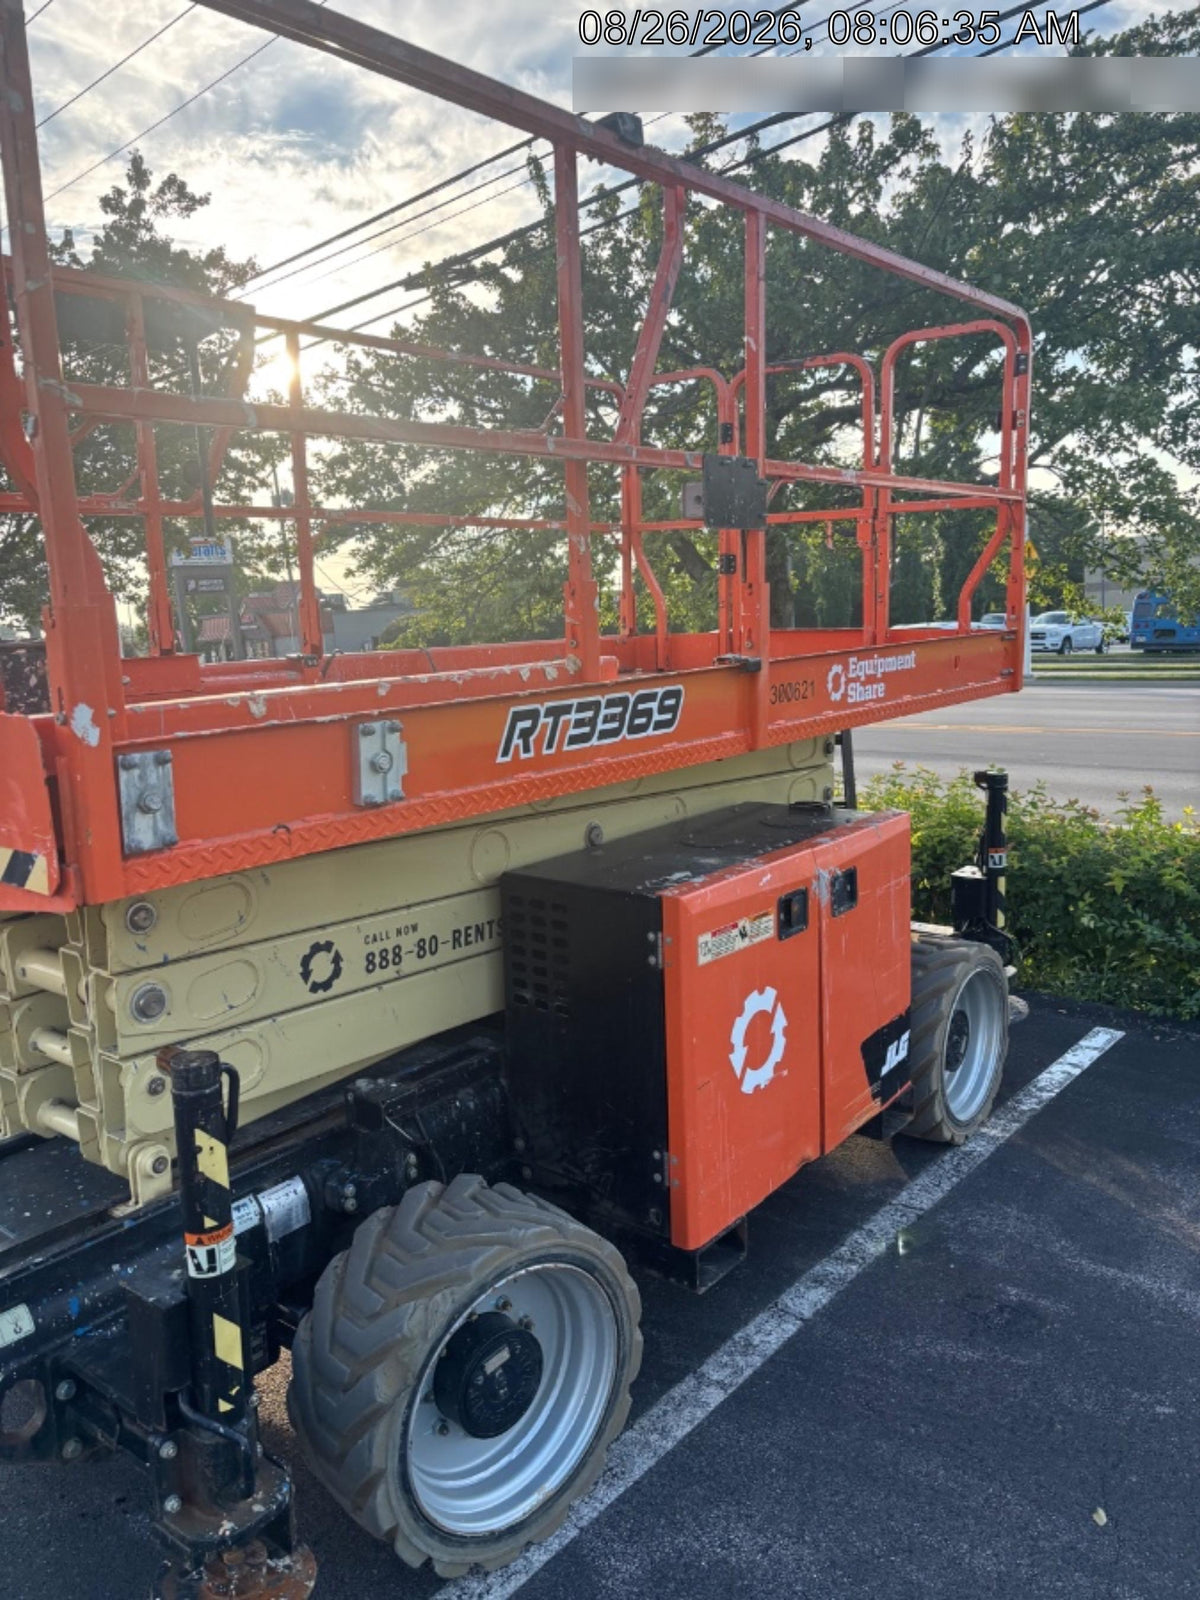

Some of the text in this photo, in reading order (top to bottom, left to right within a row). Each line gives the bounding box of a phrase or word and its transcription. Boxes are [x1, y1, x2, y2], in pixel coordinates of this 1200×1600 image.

[847, 650, 917, 681] Equipment
[769, 680, 816, 705] 300621
[847, 681, 886, 703] Share
[496, 684, 685, 764] RT3369
[363, 922, 419, 946] CALL NOW
[880, 1028, 912, 1078] JLG
